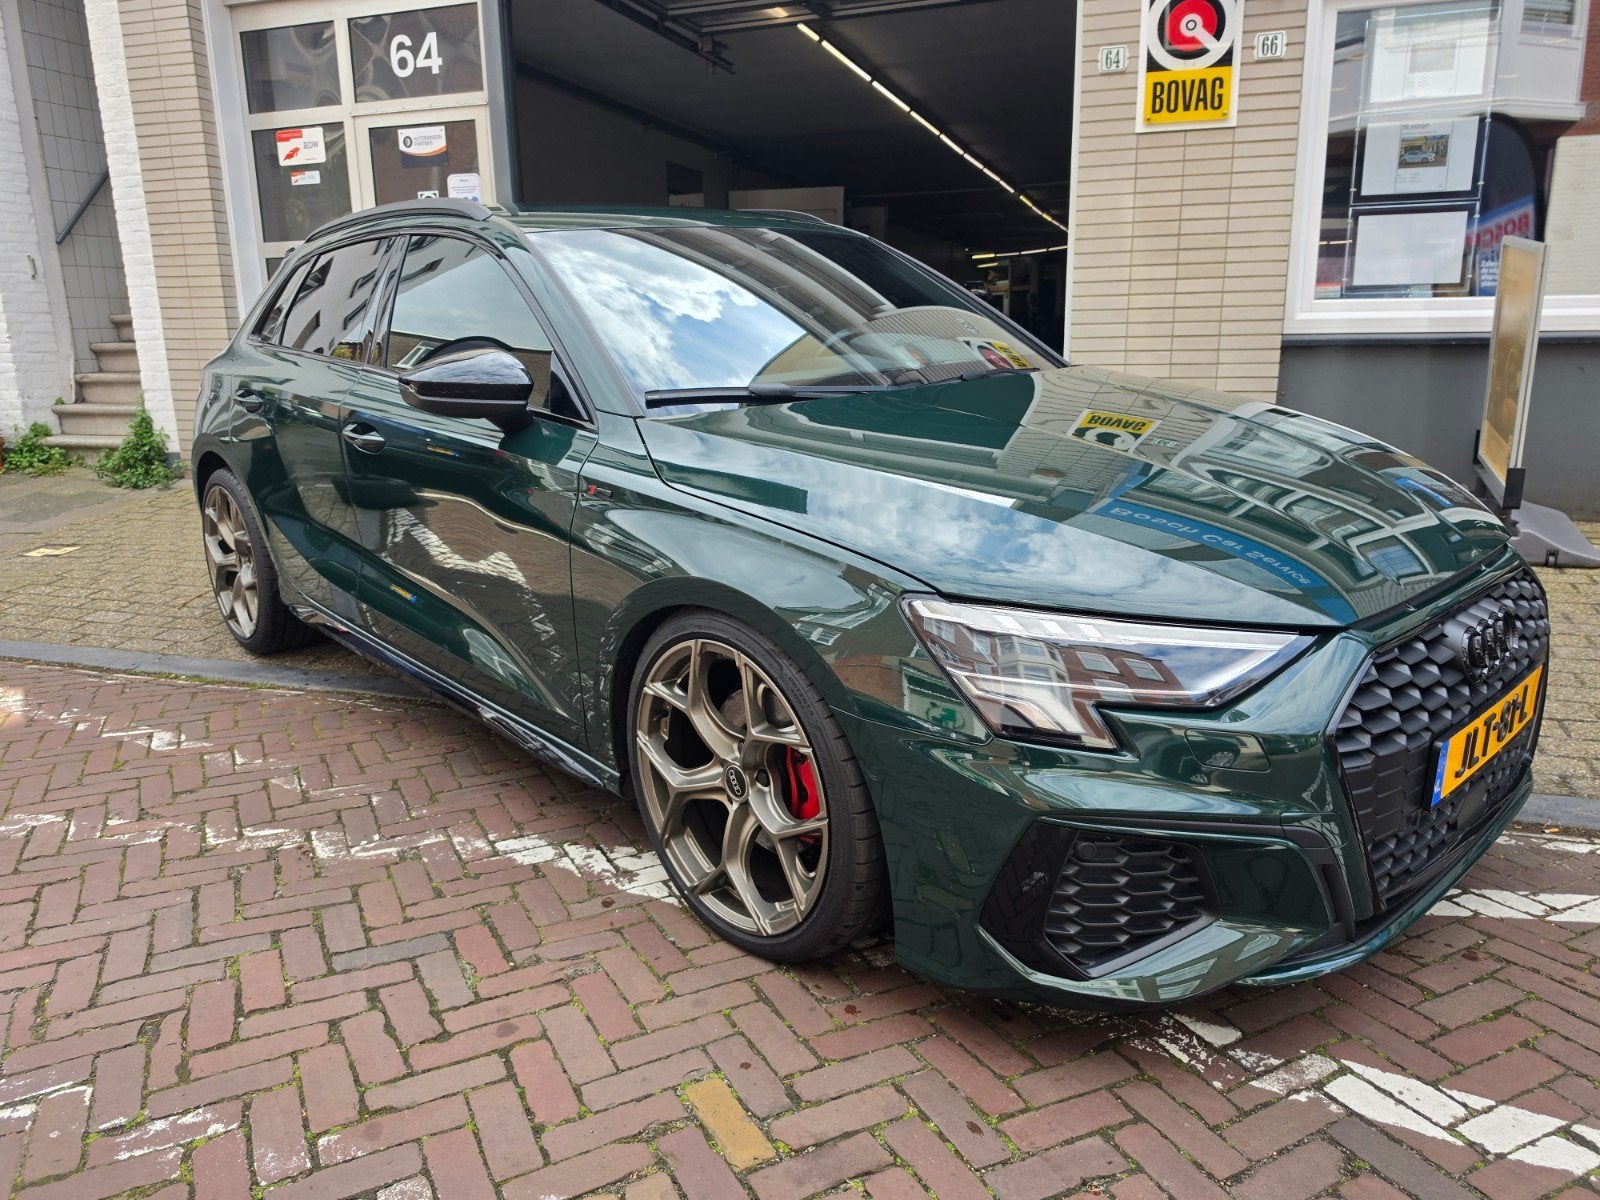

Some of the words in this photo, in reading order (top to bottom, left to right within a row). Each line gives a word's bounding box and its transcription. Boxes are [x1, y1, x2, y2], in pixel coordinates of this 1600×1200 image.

[390, 31, 443, 78] 64
[1262, 34, 1279, 56] 66
[1105, 49, 1121, 70] 64
[1151, 76, 1224, 115] BOVAG
[303, 140, 320, 149] RDW
